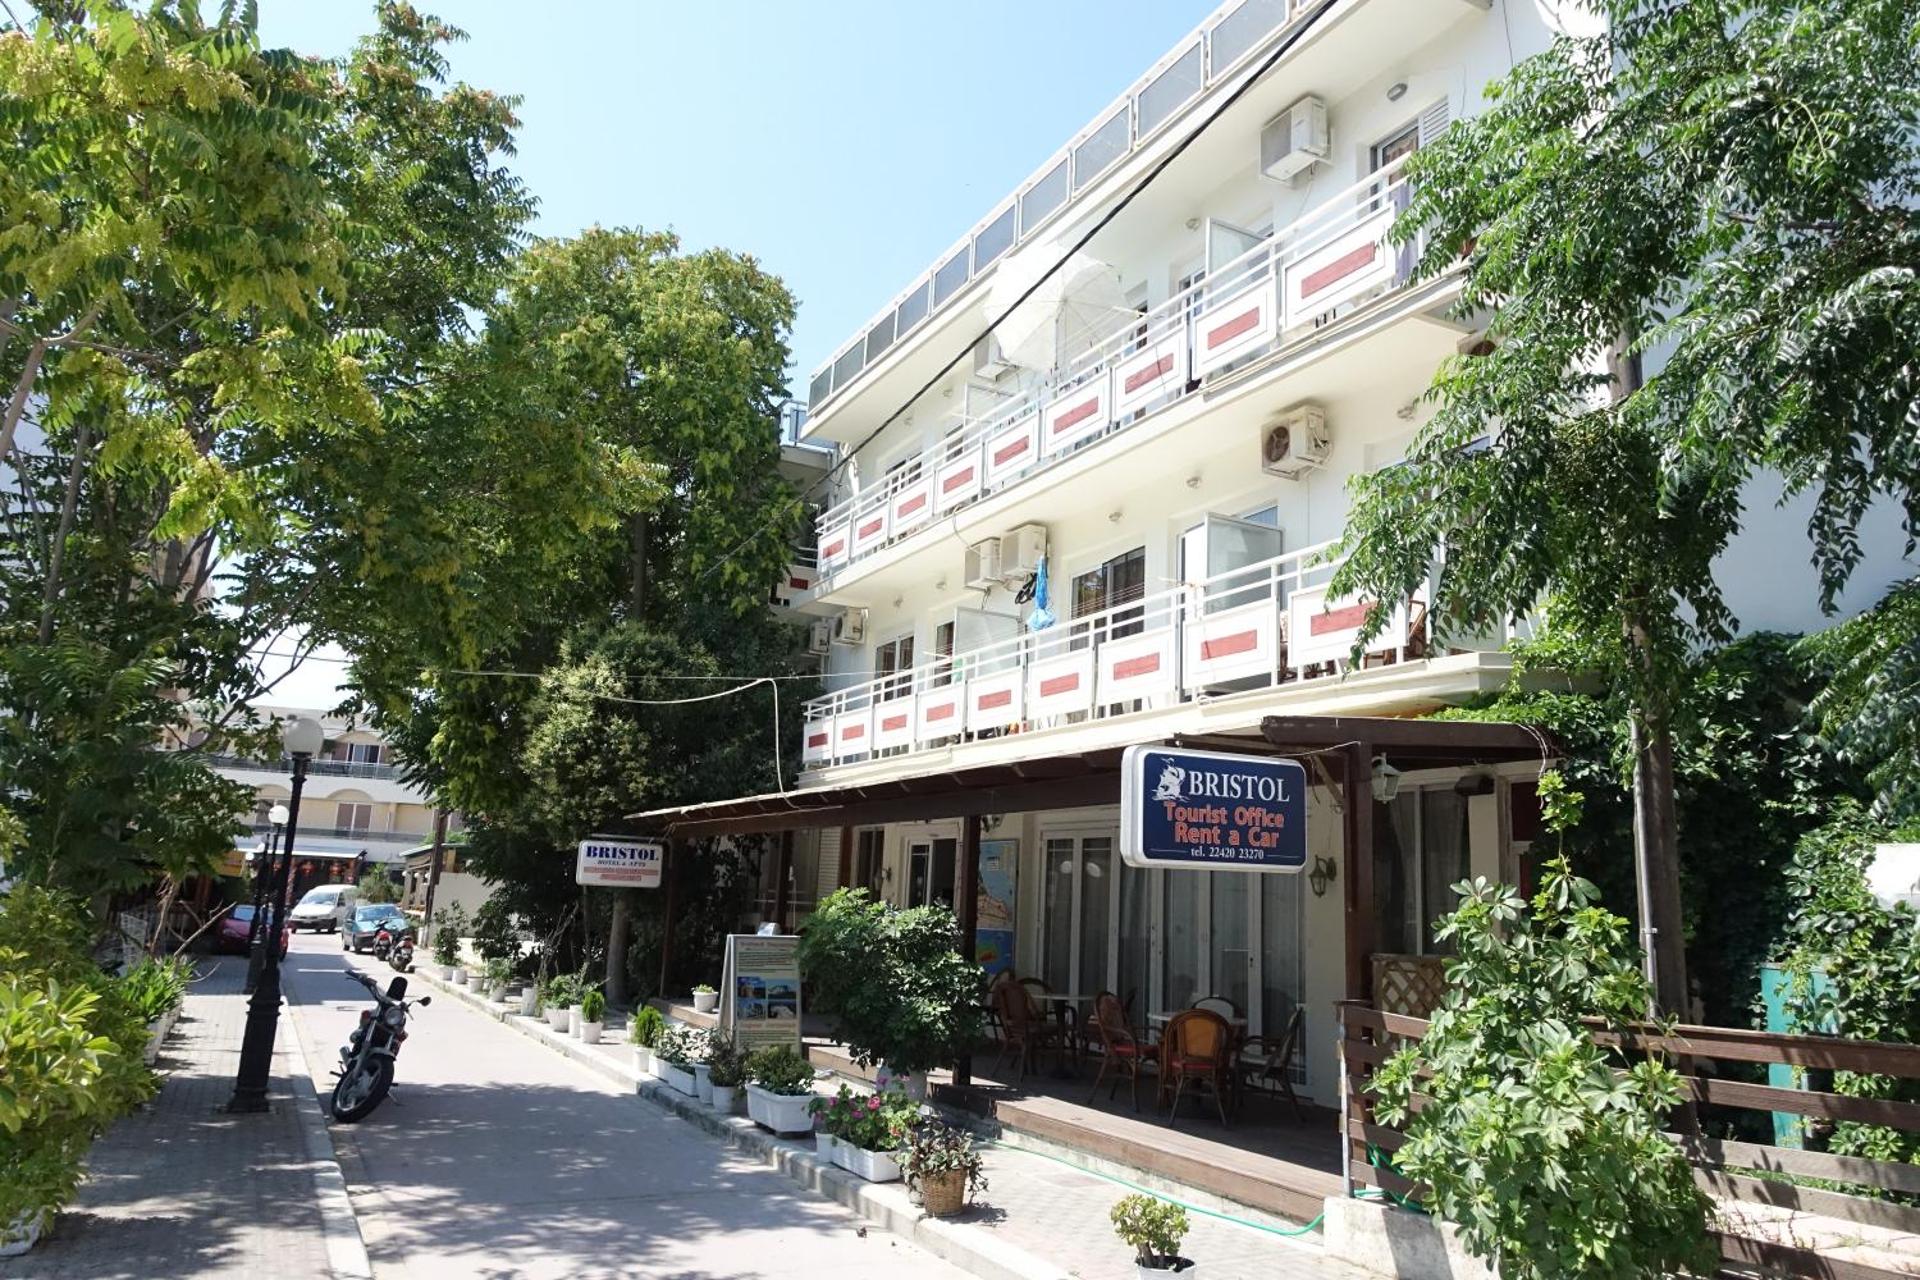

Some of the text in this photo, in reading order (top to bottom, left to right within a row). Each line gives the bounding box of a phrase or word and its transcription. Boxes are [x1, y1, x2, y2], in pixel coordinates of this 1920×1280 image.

[1189, 771, 1290, 802] BRISTOL
[1164, 800, 1284, 828] Tourist Office
[1174, 822, 1279, 848] Rent a Car
[586, 845, 659, 861] BRISTOL
[1191, 846, 1264, 860] tel. 22420 23270
